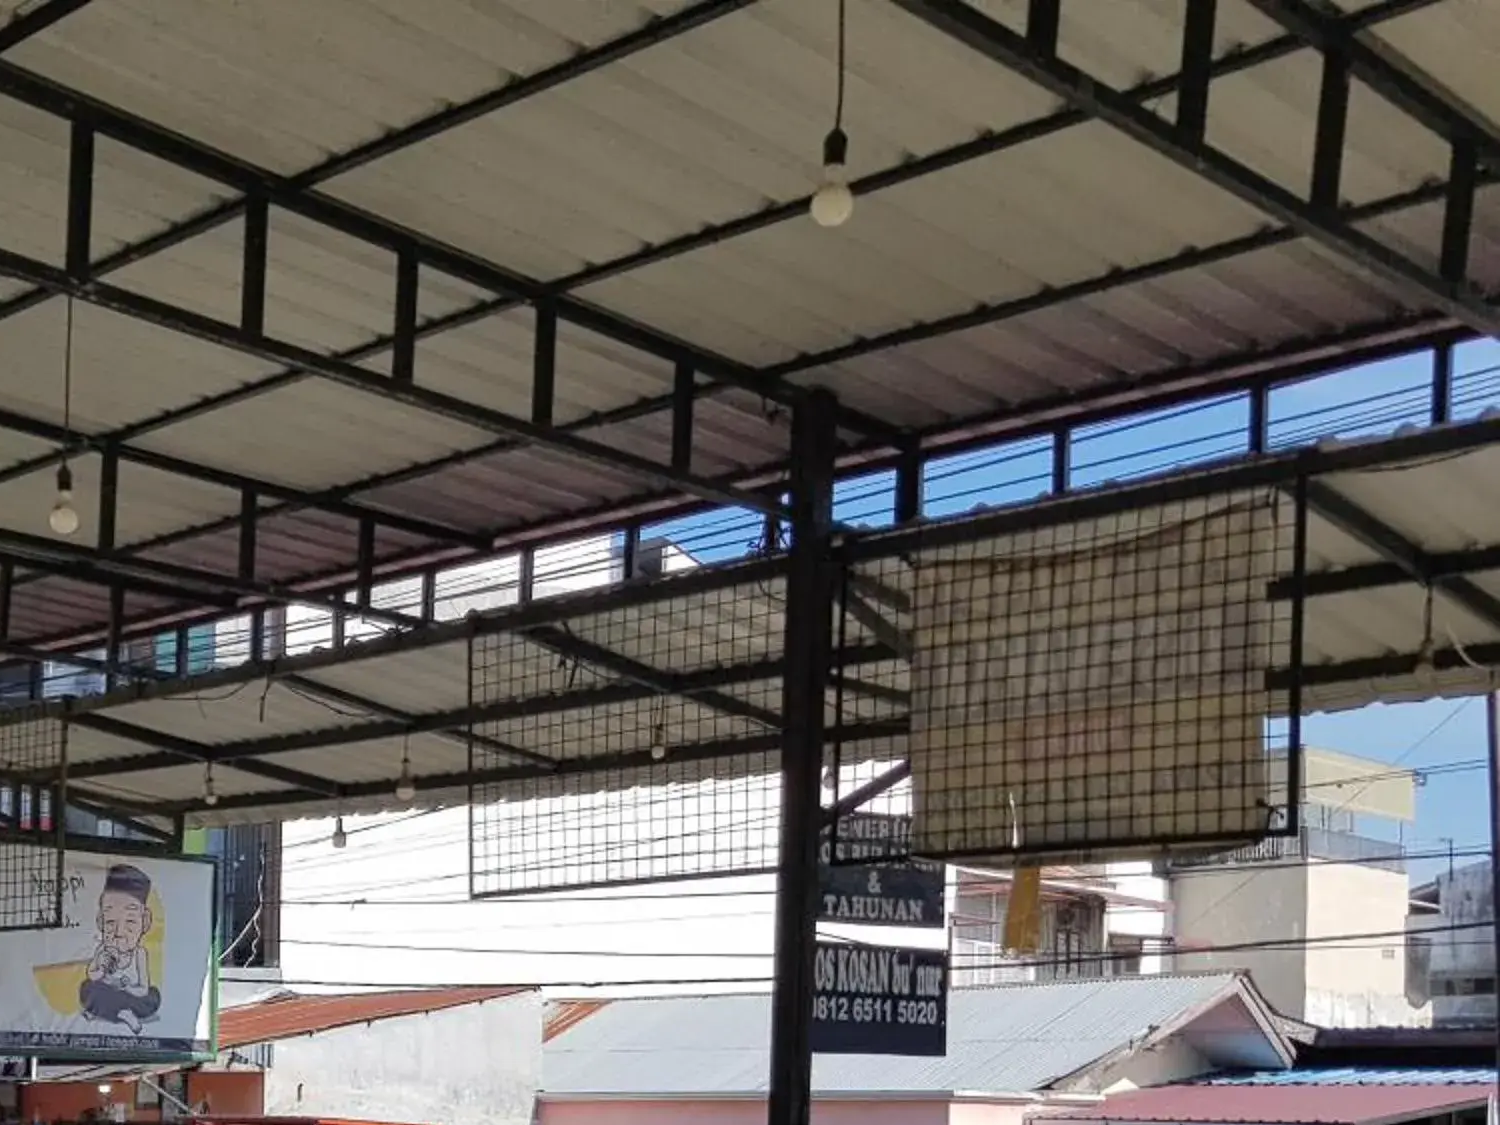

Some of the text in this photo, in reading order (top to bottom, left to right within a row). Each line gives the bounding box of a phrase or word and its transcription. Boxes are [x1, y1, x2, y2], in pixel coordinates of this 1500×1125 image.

[867, 871, 882, 893] &
[823, 894, 924, 921] TAHUNAN
[814, 946, 836, 991] OS
[836, 948, 891, 994] KOSAN
[853, 997, 893, 1023] 6511
[897, 1000, 938, 1025] 5020
